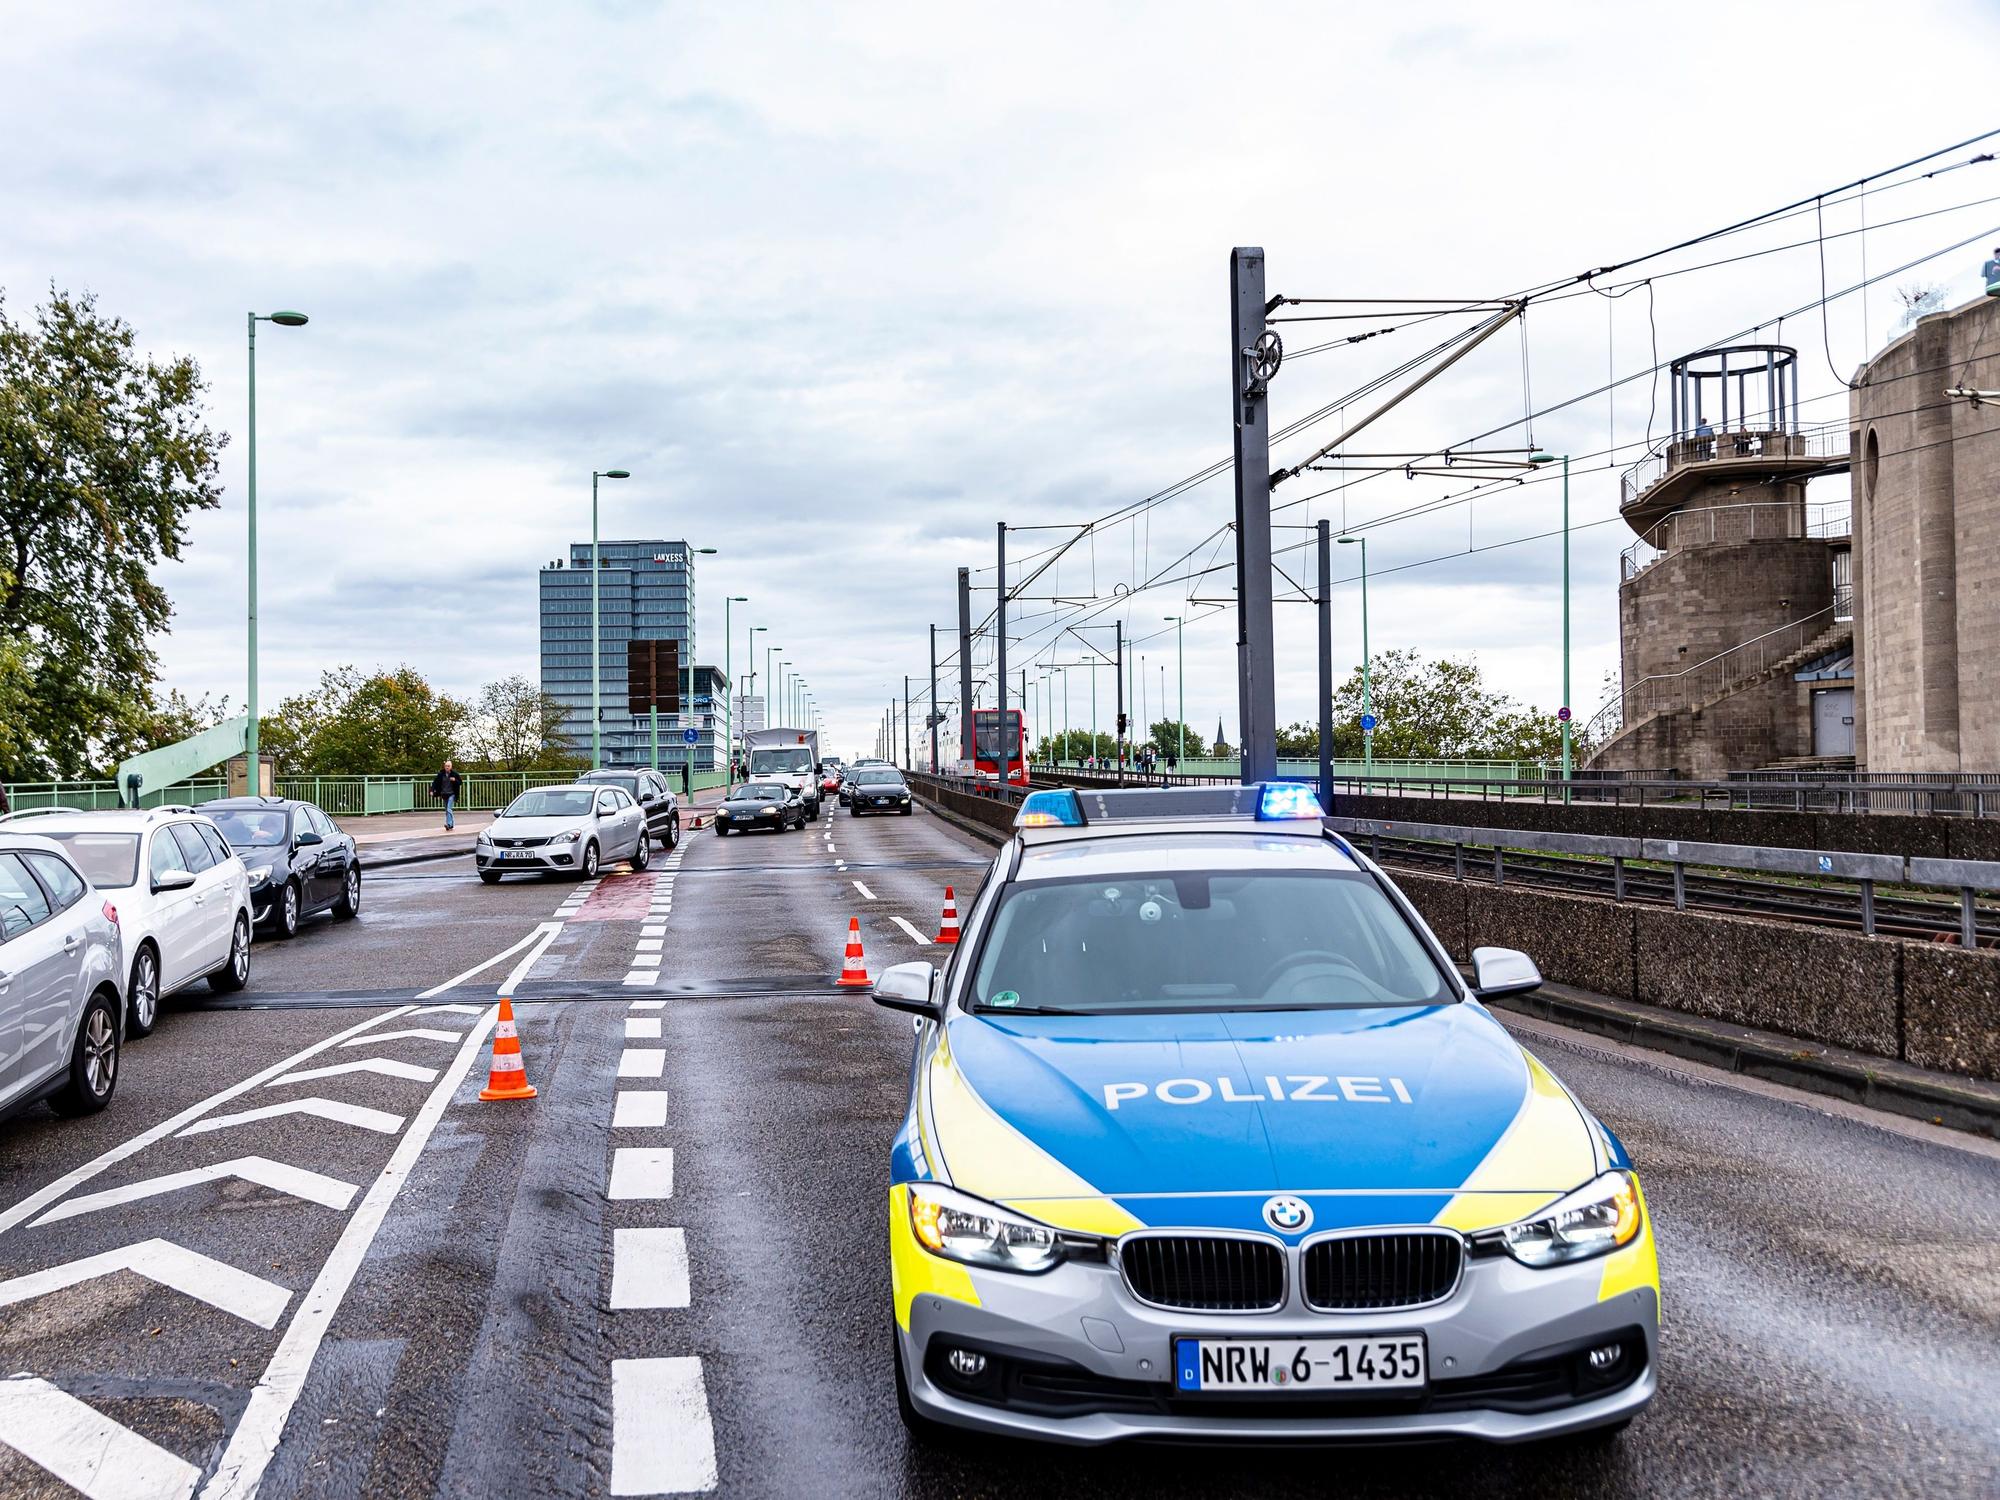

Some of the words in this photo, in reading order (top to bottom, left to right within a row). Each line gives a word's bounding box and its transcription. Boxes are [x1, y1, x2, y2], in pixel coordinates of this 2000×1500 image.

[653, 553, 683, 563] LANXESS
[1103, 1076, 1413, 1111] POLIZEI
[1185, 1369, 1194, 1380] D
[1202, 1346, 1270, 1383] NRW
[1291, 1342, 1421, 1382] 6-1435
